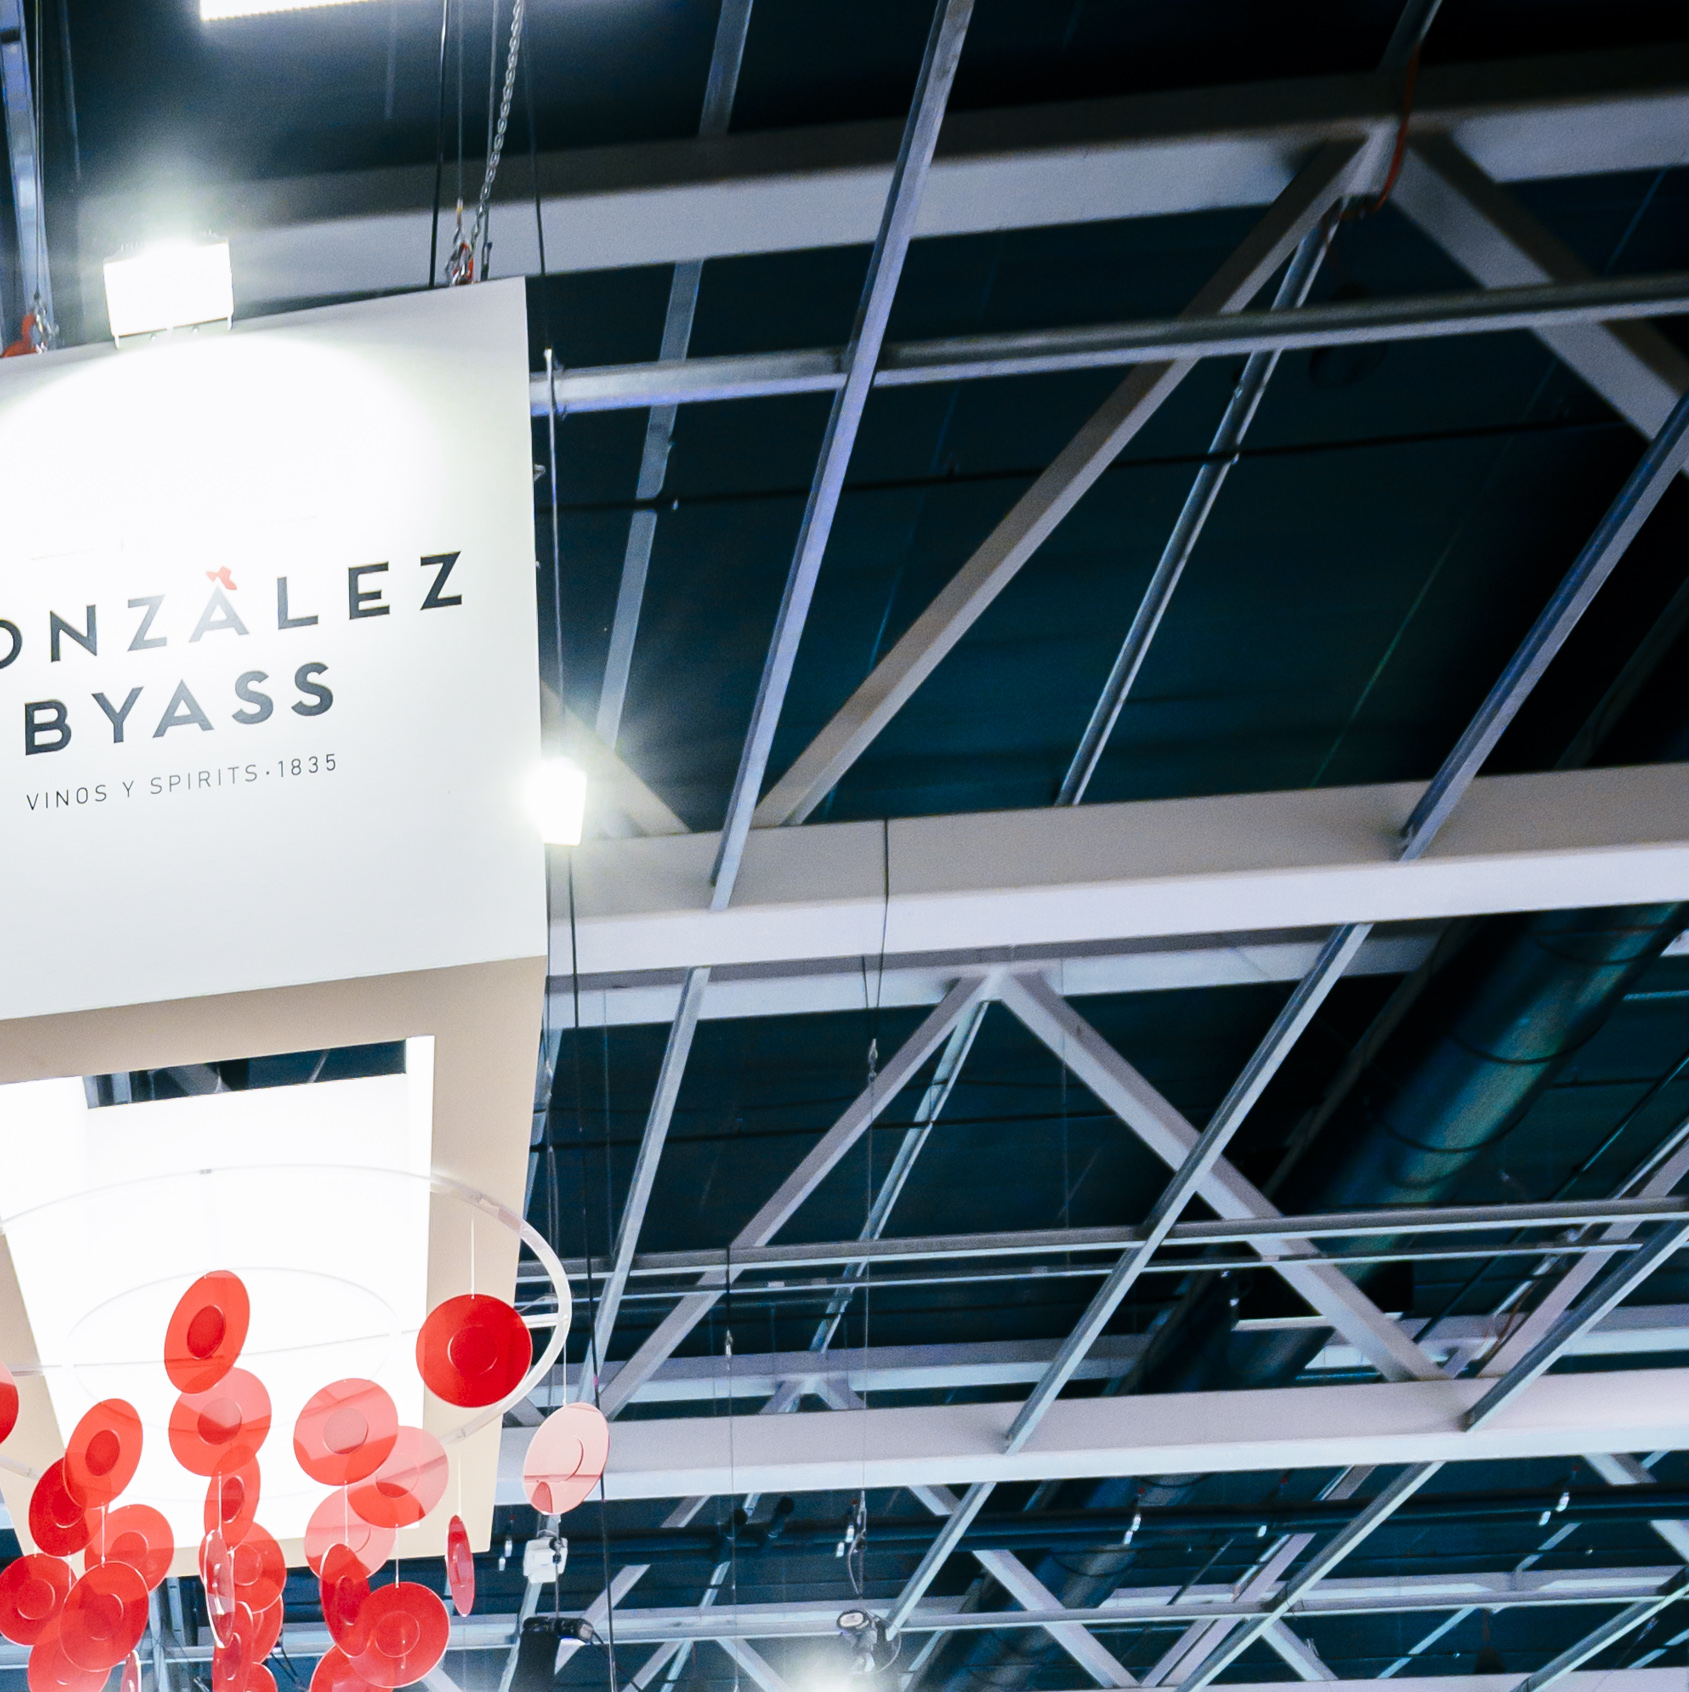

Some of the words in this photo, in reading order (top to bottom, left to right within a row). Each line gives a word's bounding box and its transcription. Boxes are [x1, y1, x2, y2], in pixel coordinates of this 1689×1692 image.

[23, 661, 335, 756] BYASS
[25, 783, 108, 812] VINOS
[122, 780, 136, 799] Y
